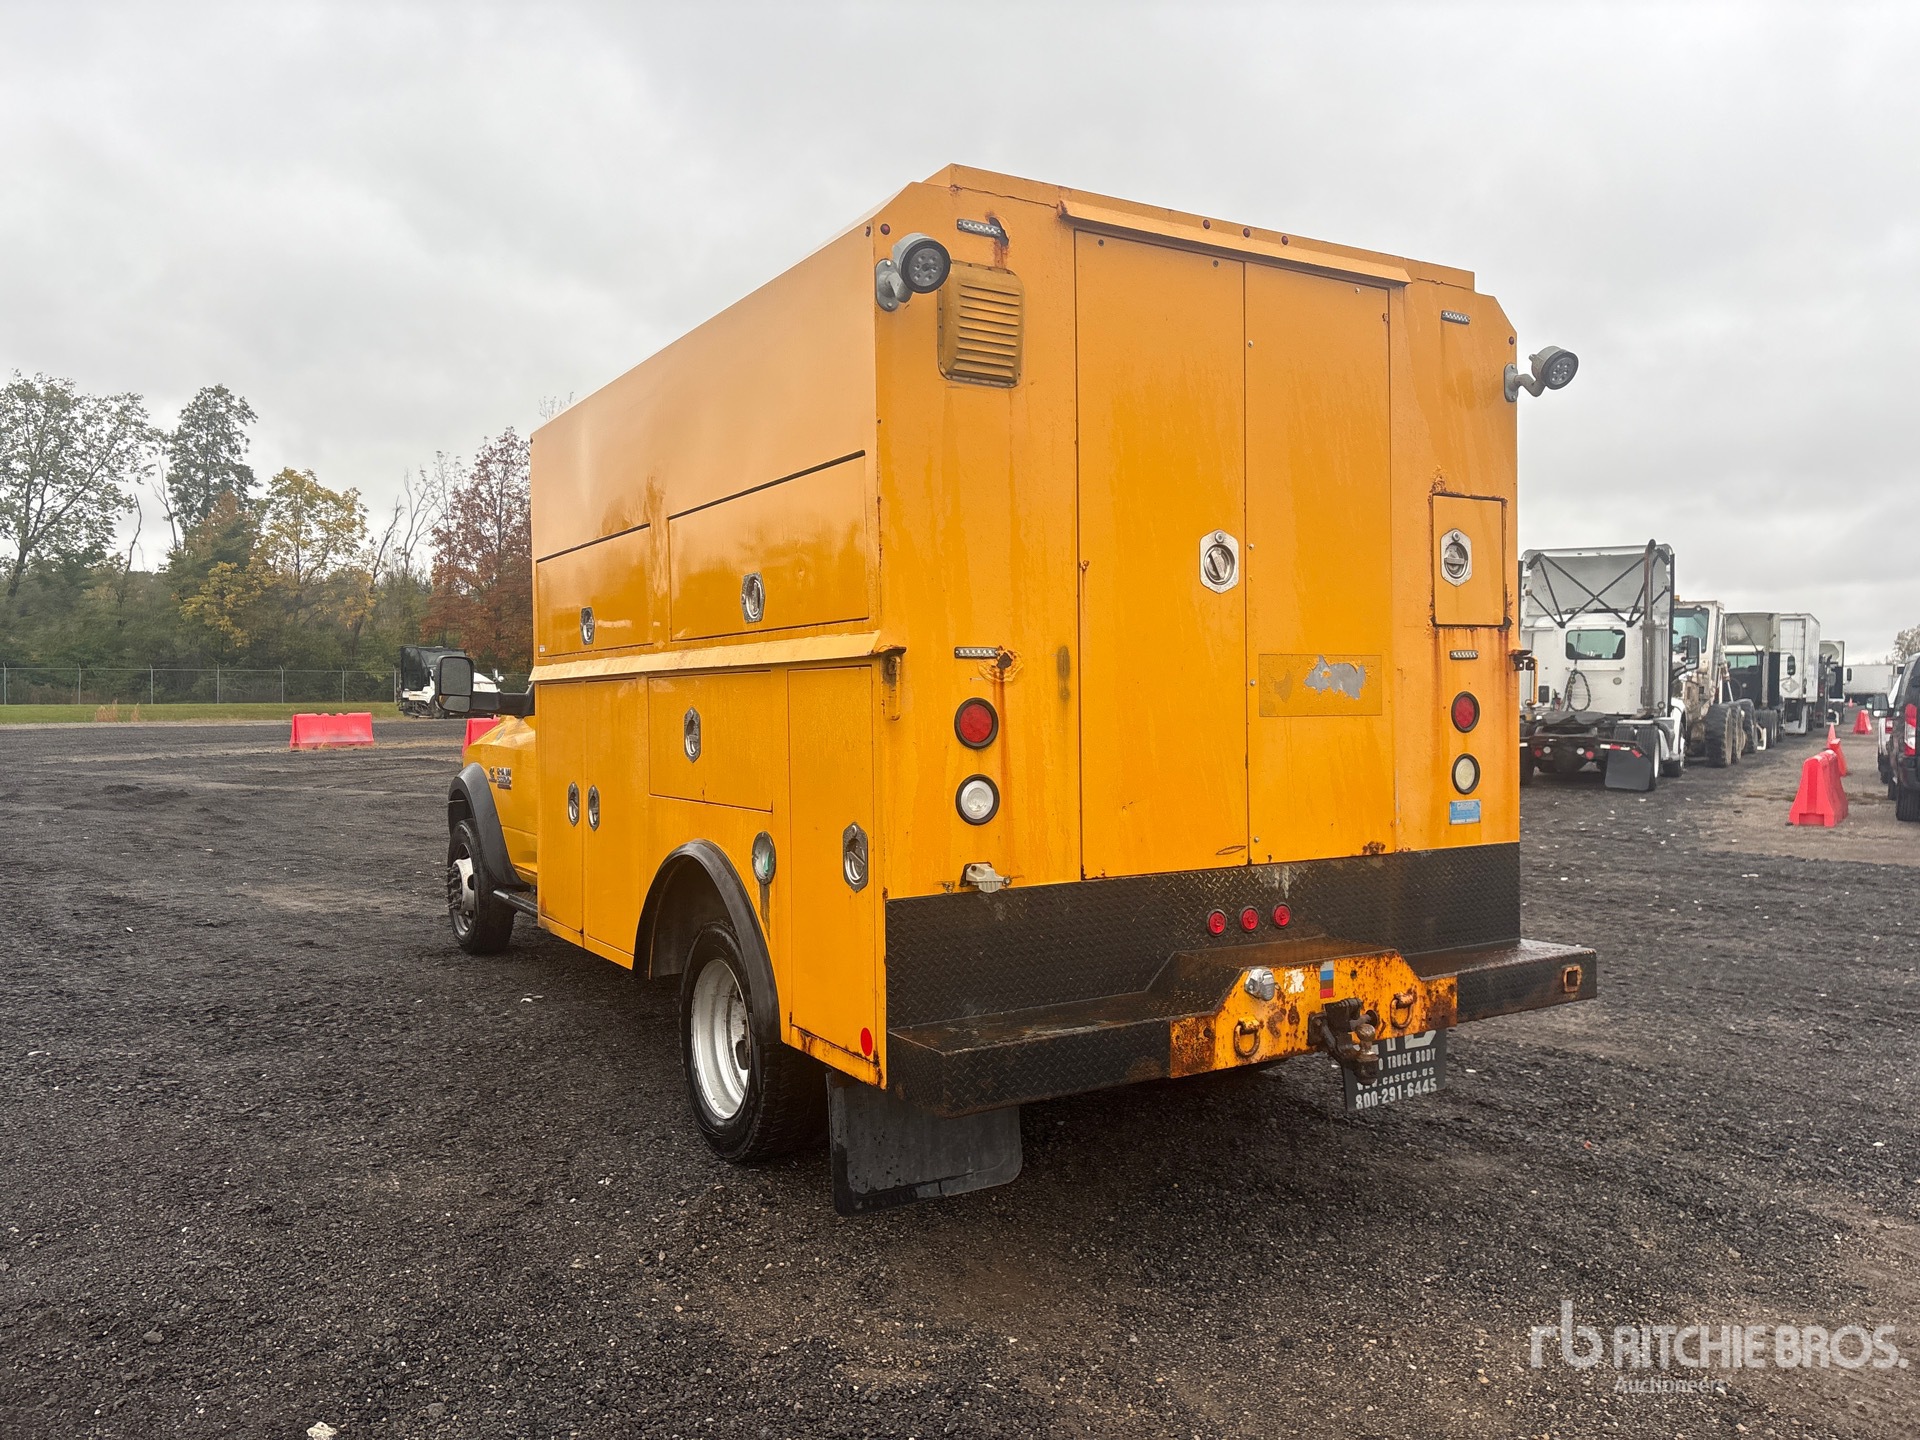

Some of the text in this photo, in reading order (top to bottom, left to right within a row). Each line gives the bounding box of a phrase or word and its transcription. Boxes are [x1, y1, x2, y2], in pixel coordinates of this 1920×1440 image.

[1387, 1052, 1412, 1069] TRUCK
[1415, 1048, 1437, 1063] BODY
[1355, 1077, 1437, 1110] 800-291-6445
